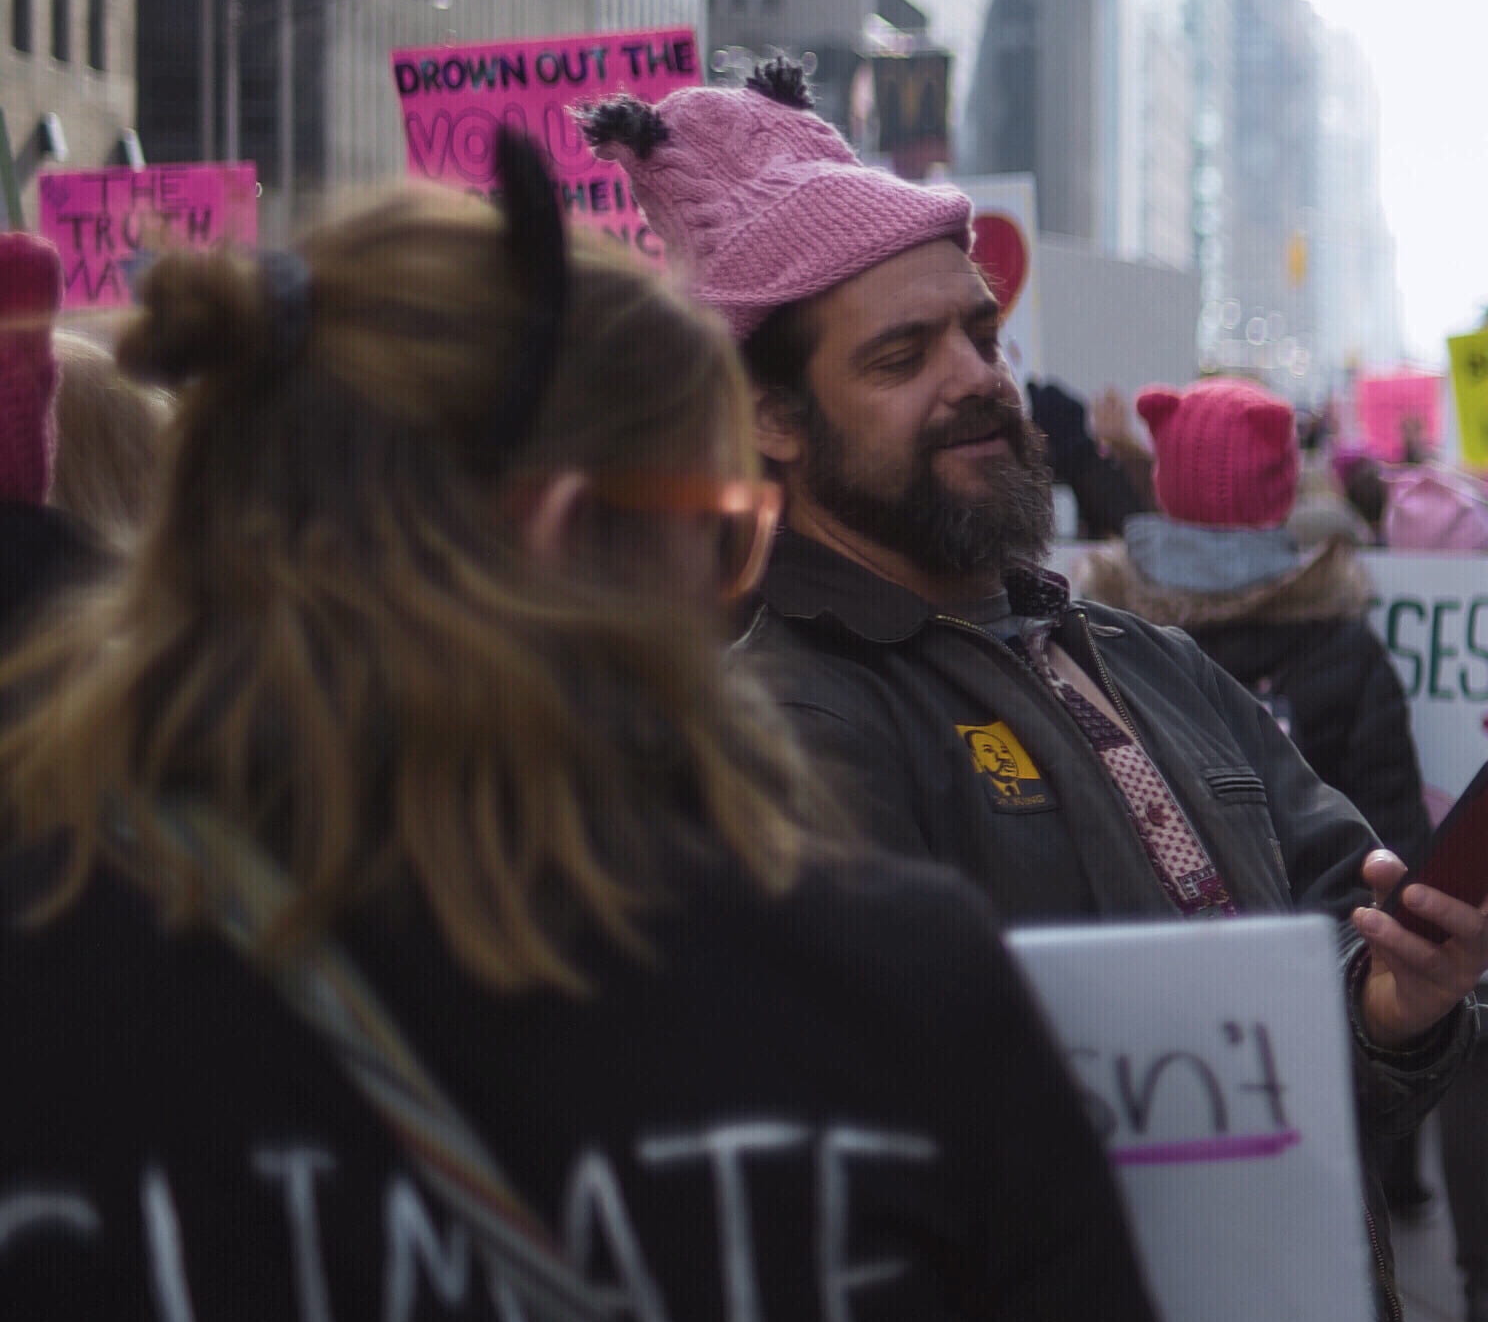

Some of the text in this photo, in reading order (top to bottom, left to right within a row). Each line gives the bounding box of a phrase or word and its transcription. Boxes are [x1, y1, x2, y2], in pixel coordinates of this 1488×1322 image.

[394, 34, 695, 96] DROWN OUT THE
[80, 171, 188, 214] THE
